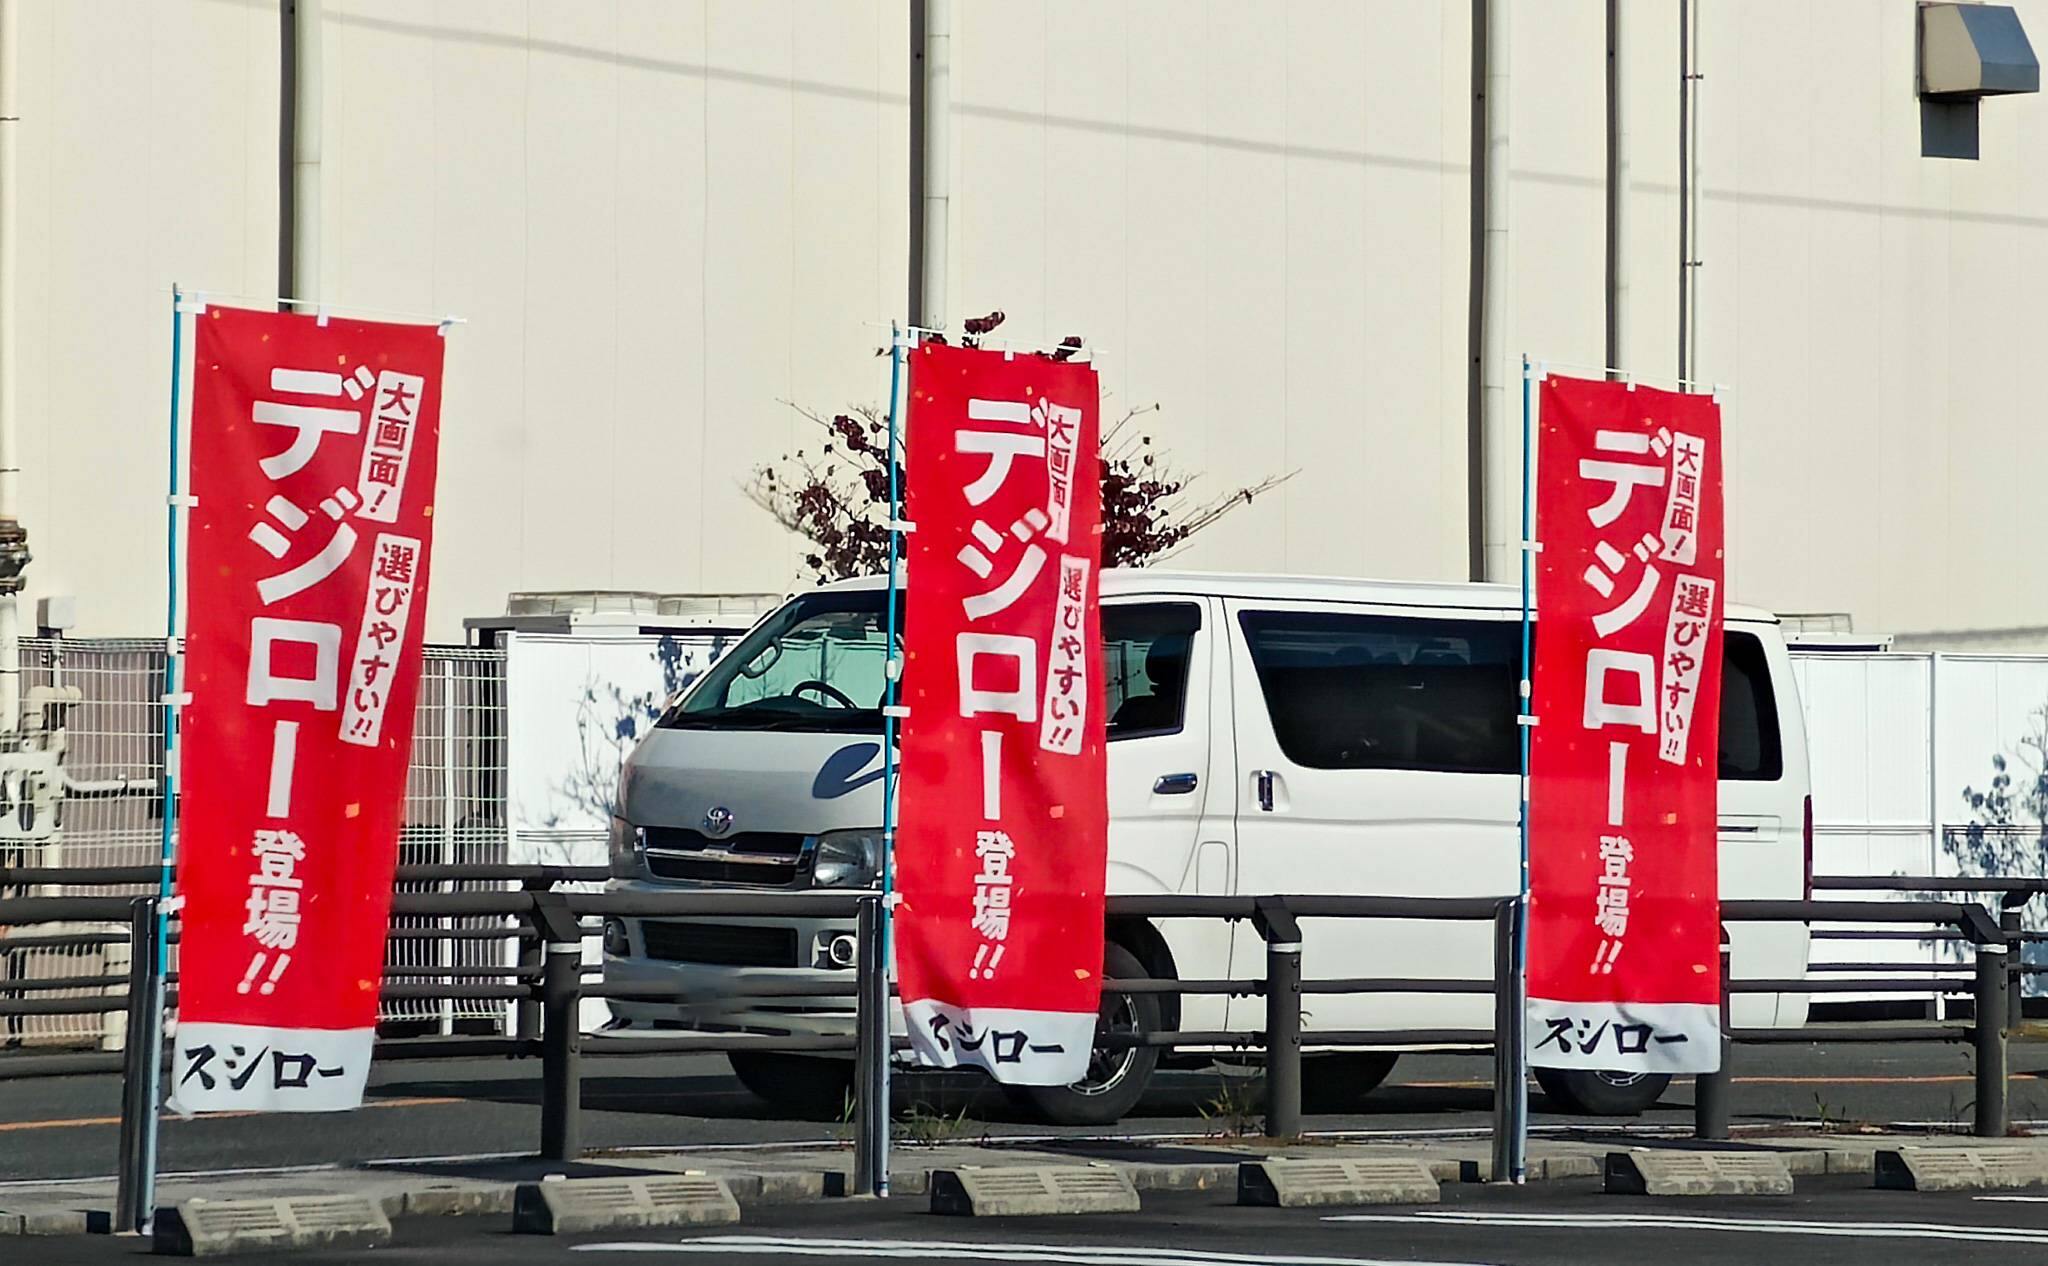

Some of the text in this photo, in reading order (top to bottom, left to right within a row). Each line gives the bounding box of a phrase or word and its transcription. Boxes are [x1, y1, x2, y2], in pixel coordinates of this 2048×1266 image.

[367, 382, 415, 513] 大画面!
[1534, 1016, 1689, 1055] スシロー
[181, 1044, 345, 1091] スシロー
